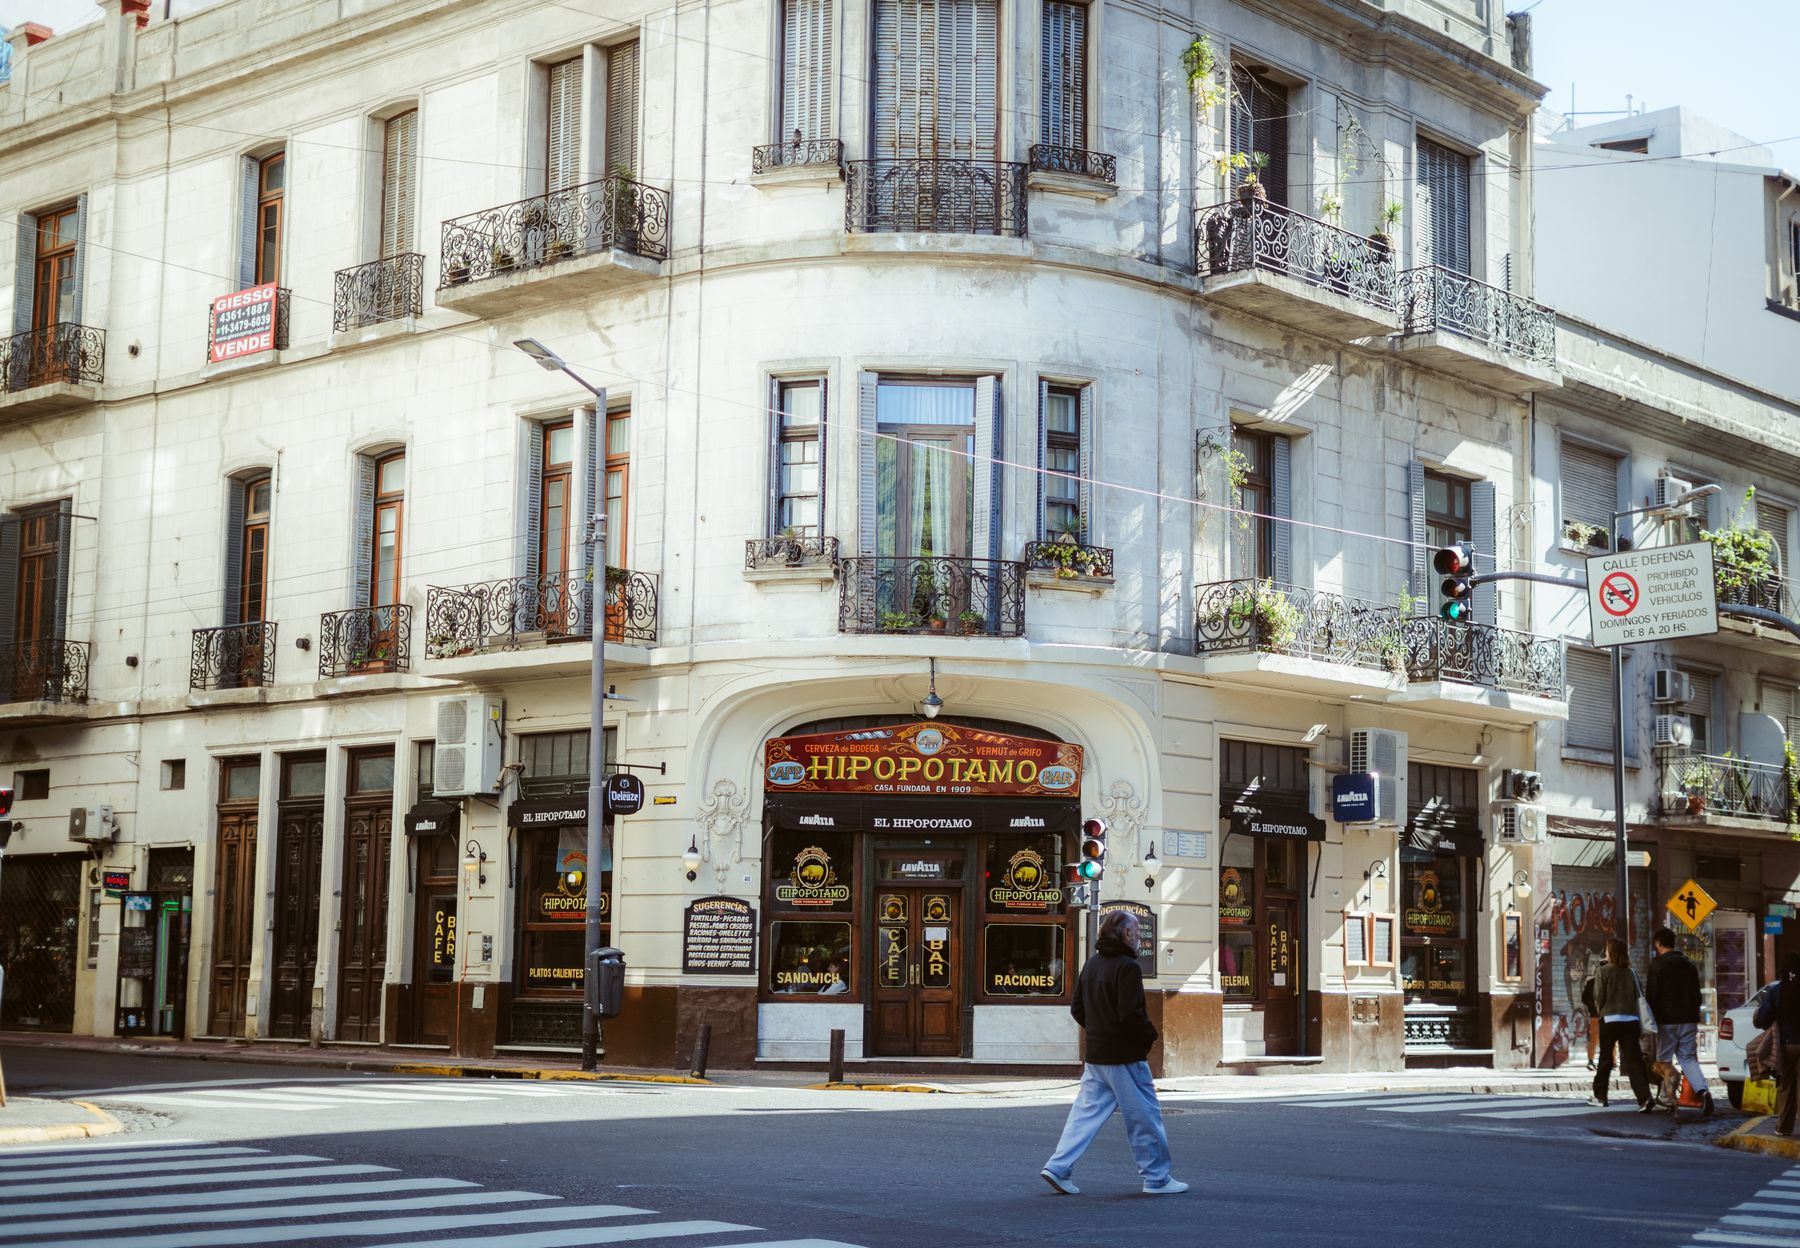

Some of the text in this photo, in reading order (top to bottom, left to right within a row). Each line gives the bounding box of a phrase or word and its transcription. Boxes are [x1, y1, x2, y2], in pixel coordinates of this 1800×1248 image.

[216, 288, 274, 311] GIESSO
[220, 302, 269, 322] 4361-1887
[221, 314, 270, 335] 11-3479-6039
[214, 334, 270, 358] VENDE
[1603, 550, 1694, 571] CALLE DEFENSA
[1647, 567, 1698, 581] PROHIBIDO
[1648, 580, 1696, 594] CIRCULAR
[1650, 592, 1702, 606] VEHICULOS
[1600, 608, 1708, 629] DOMINGOS Y FERIADOS
[1623, 629, 1635, 638] DE
[1639, 628, 1644, 636] 8
[1648, 627, 1655, 635] A
[1659, 625, 1670, 634] 20
[805, 744, 839, 752] CERVEZA
[850, 744, 879, 753] BODEGA
[976, 746, 1008, 756] VERMUT
[1018, 747, 1042, 757] GRIFO
[806, 756, 1037, 784] HIPOPOTAMO
[1042, 770, 1072, 785] BAR
[611, 791, 638, 801] Deleuze
[523, 810, 586, 822] EL HIPOPOTAMO
[799, 814, 834, 826] LAVAZZA
[1010, 816, 1045, 827] LAVAZZA
[874, 818, 972, 828] EL HIPOPOTAMO
[1251, 822, 1307, 835] EL HIPOPOTAMO
[901, 861, 940, 872] LAVAZZA
[780, 888, 846, 898] HIPOPOTAMO
[994, 891, 1059, 901] HIPOPOTAMO
[693, 901, 748, 913] SUGERENCIAS
[1408, 913, 1451, 926] HIPOPOTAMO
[434, 911, 444, 963] CAFE
[447, 916, 456, 955] BAR
[887, 929, 900, 980] CAFE
[928, 940, 944, 975] BAR
[529, 968, 584, 978] PLATOS CALIENTES
[777, 972, 840, 984] SANDWICH
[994, 974, 1055, 986] RACIONES
